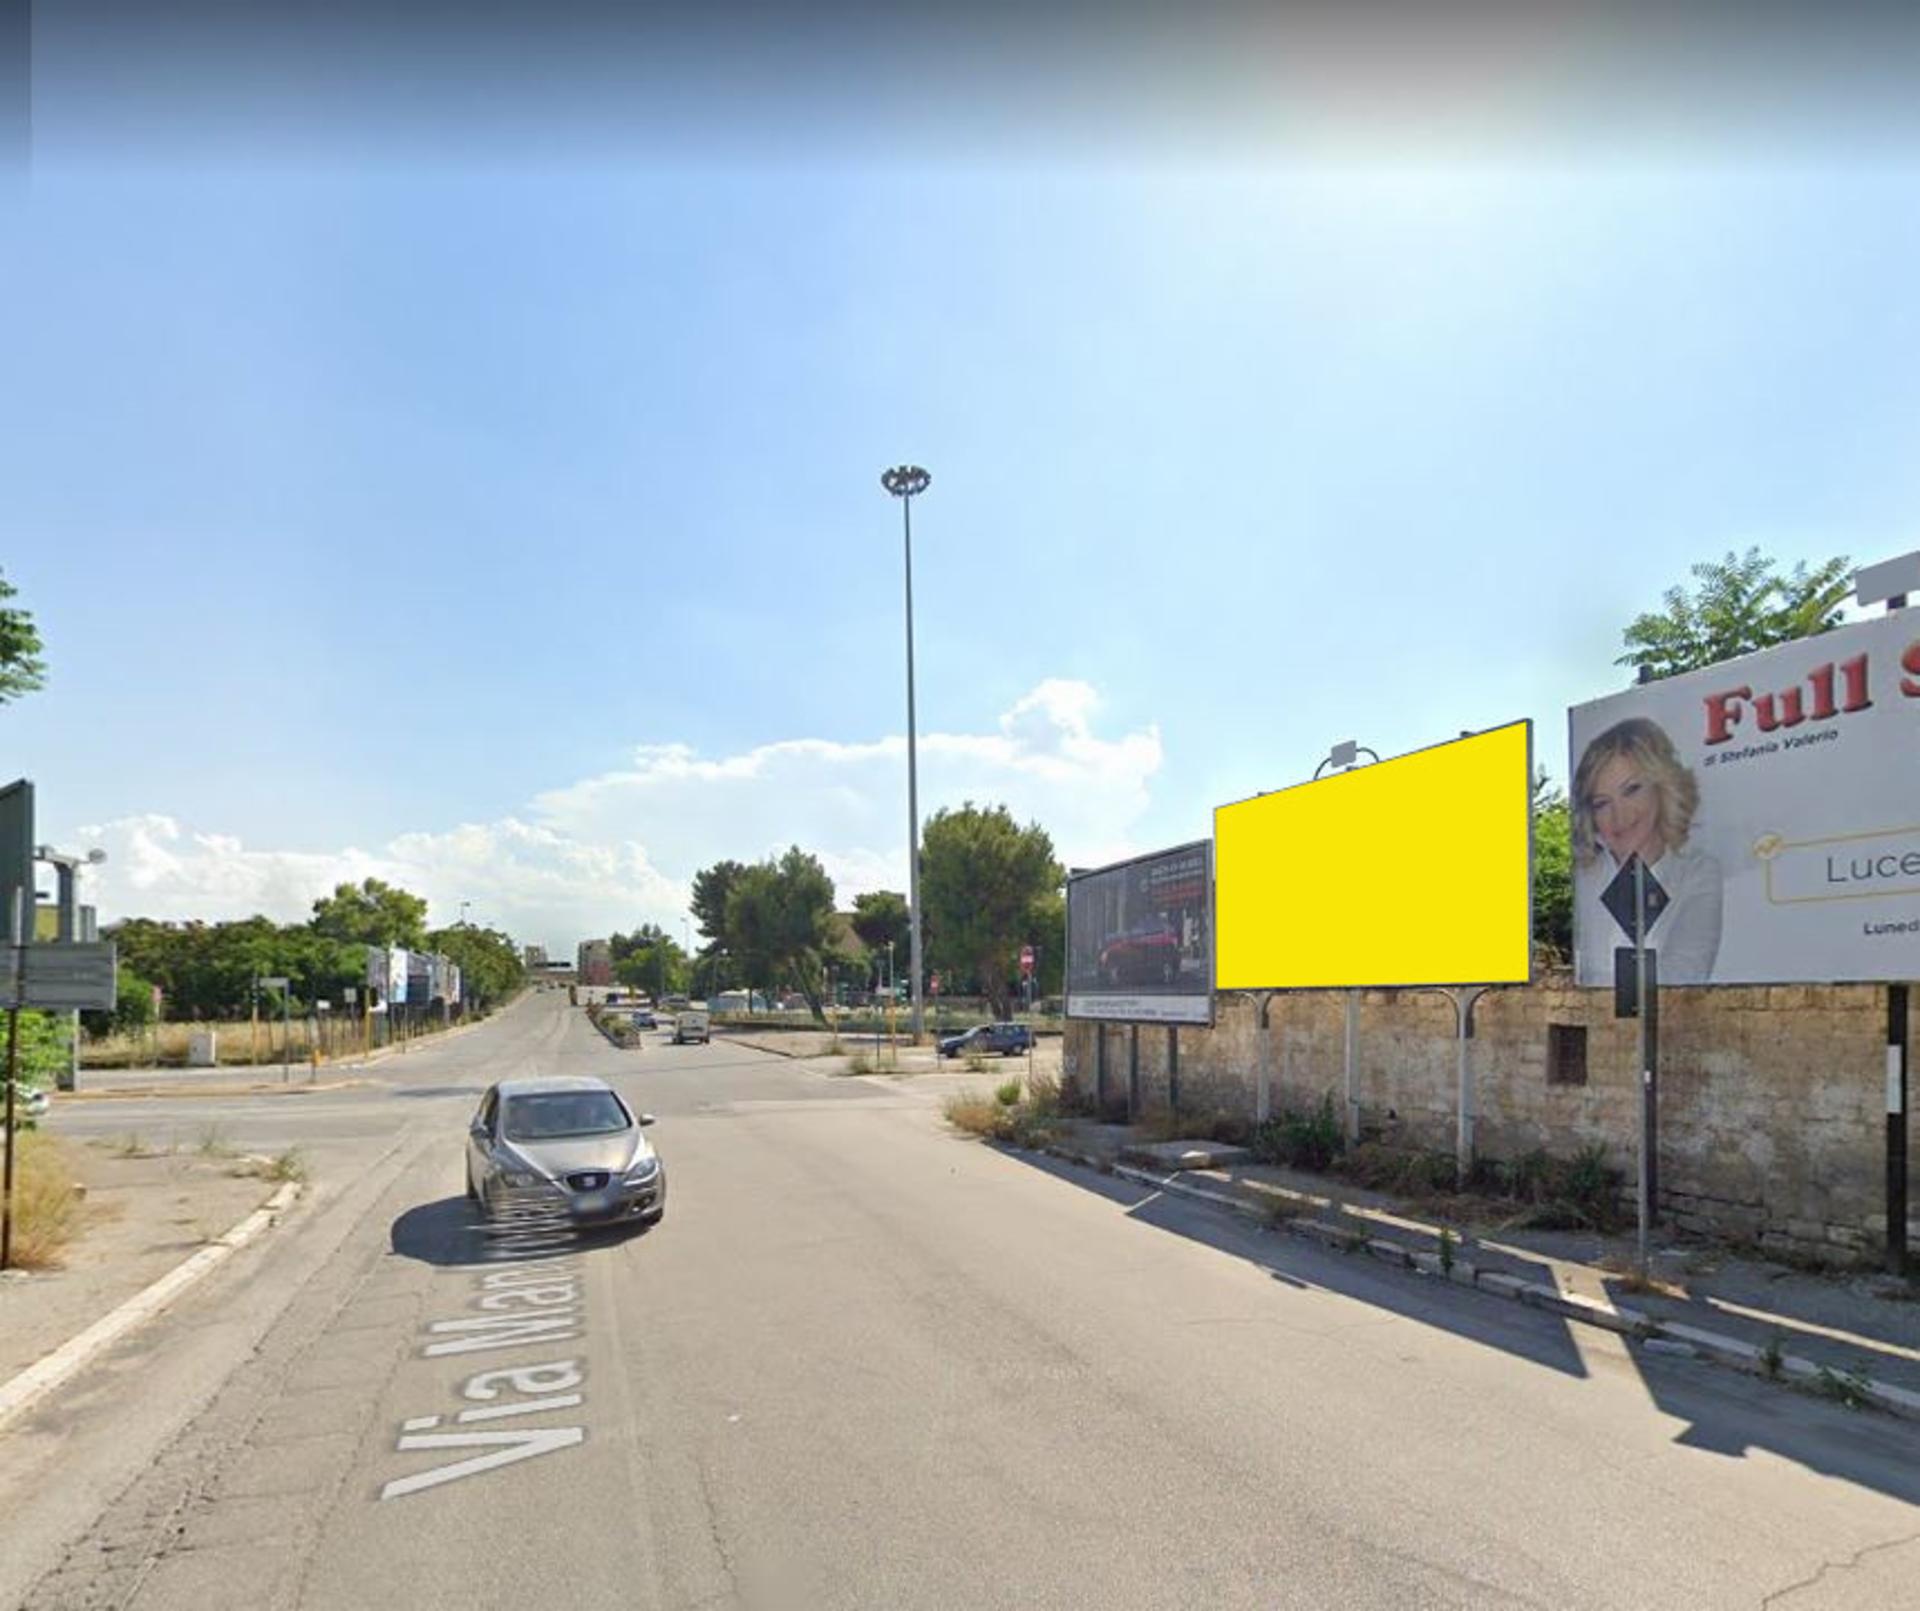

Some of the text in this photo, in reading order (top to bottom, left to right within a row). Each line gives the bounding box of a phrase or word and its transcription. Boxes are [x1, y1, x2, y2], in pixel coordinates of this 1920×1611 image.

[1703, 653, 1874, 745] Full
[1719, 742, 1778, 764] Stefania
[1783, 729, 1838, 750] Valerio
